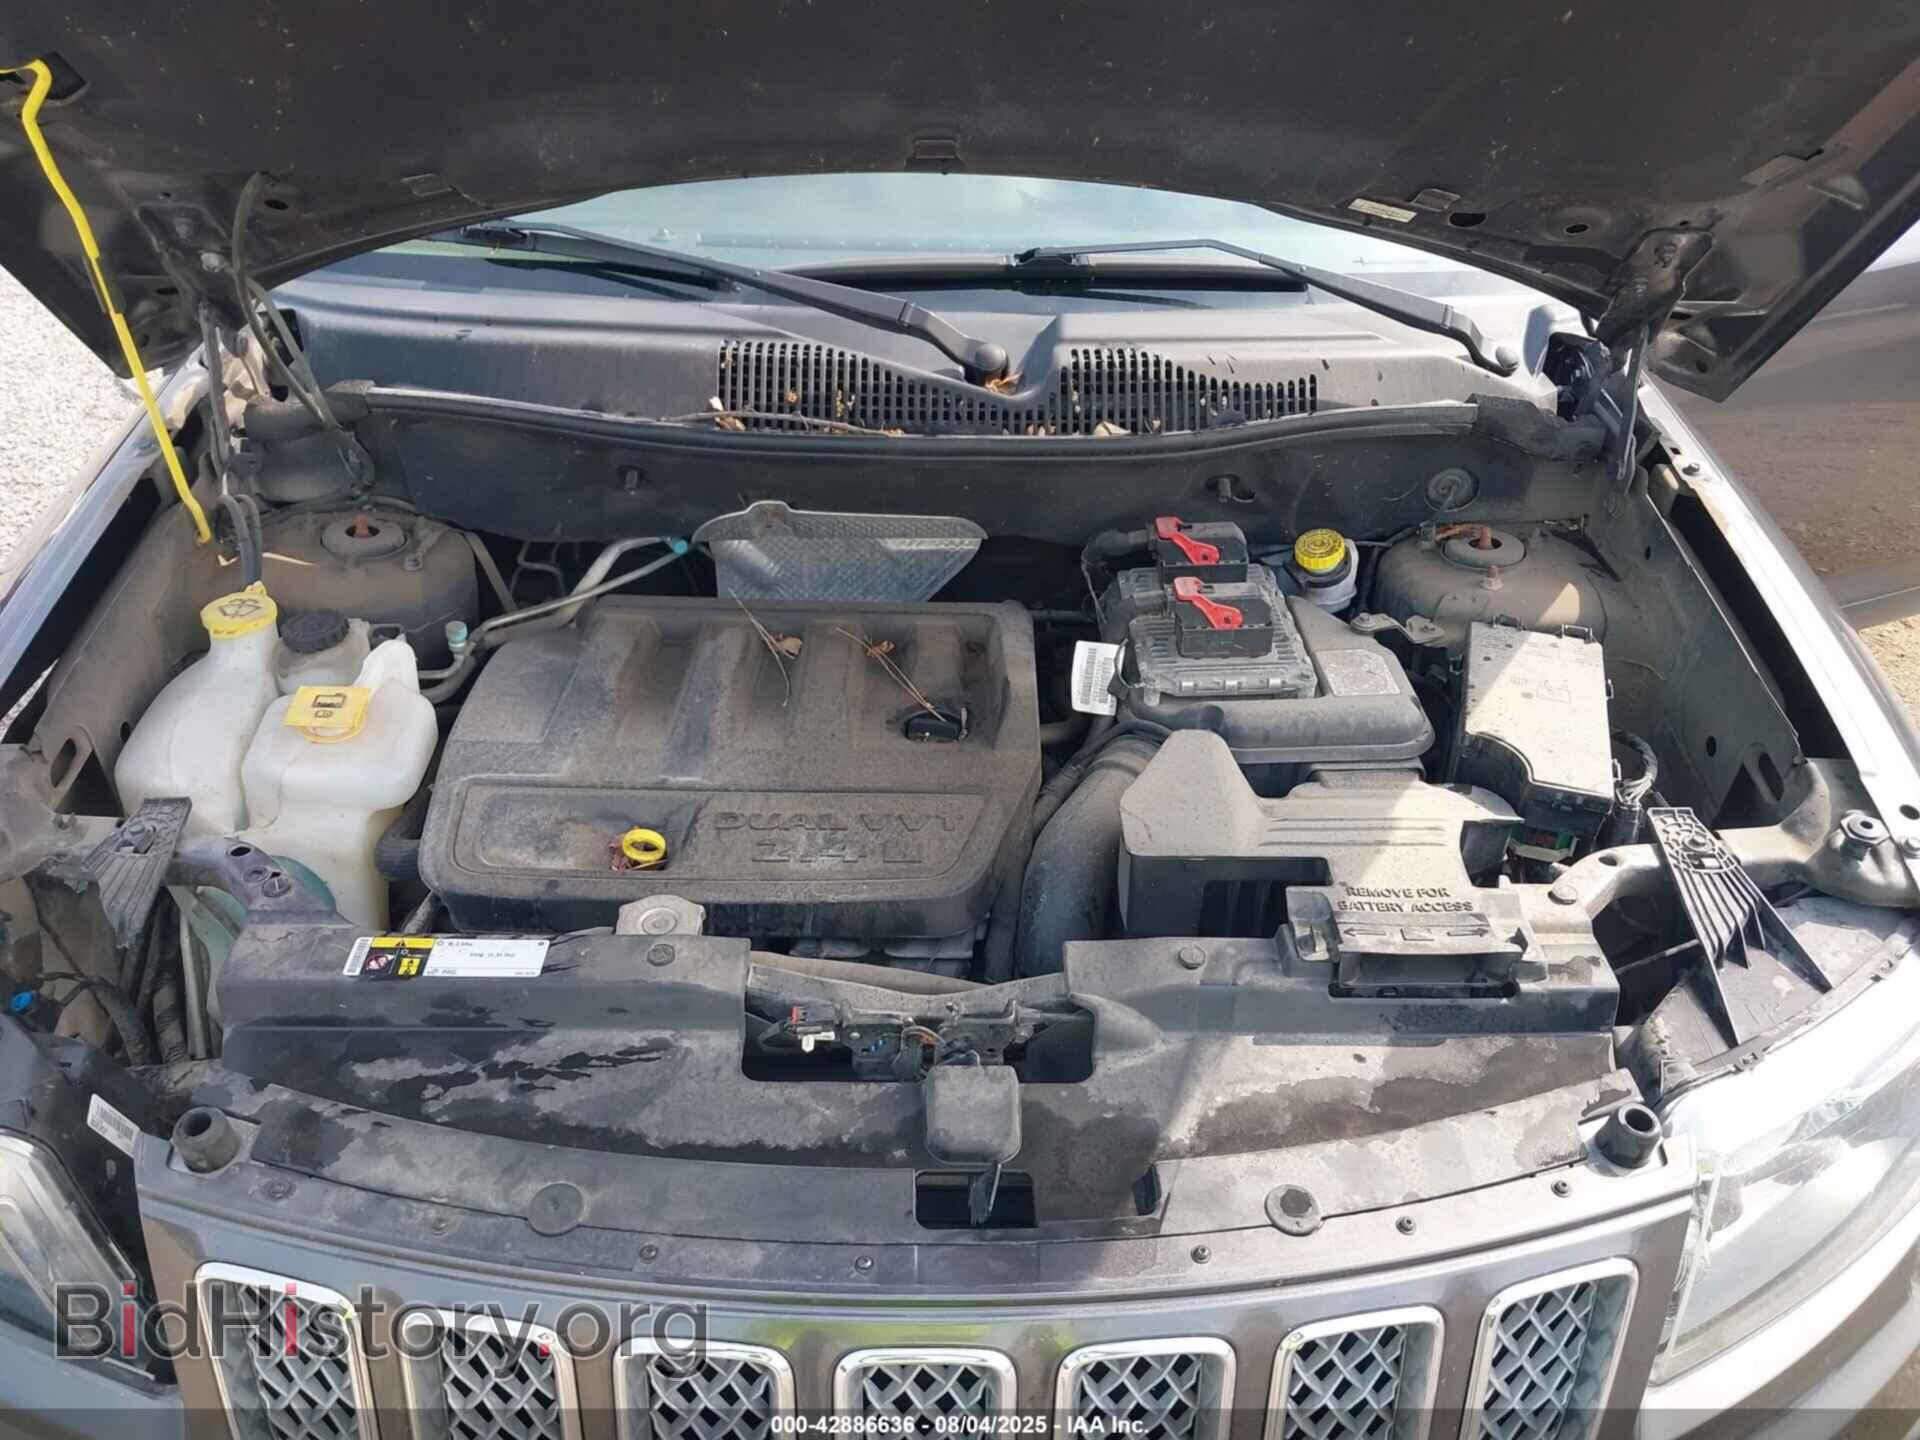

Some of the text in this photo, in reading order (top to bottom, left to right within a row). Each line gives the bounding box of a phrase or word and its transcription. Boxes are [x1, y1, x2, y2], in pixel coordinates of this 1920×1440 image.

[1345, 886, 1451, 899] REMOVE FOR
[1337, 900, 1474, 913] BATTERY ACCESS
